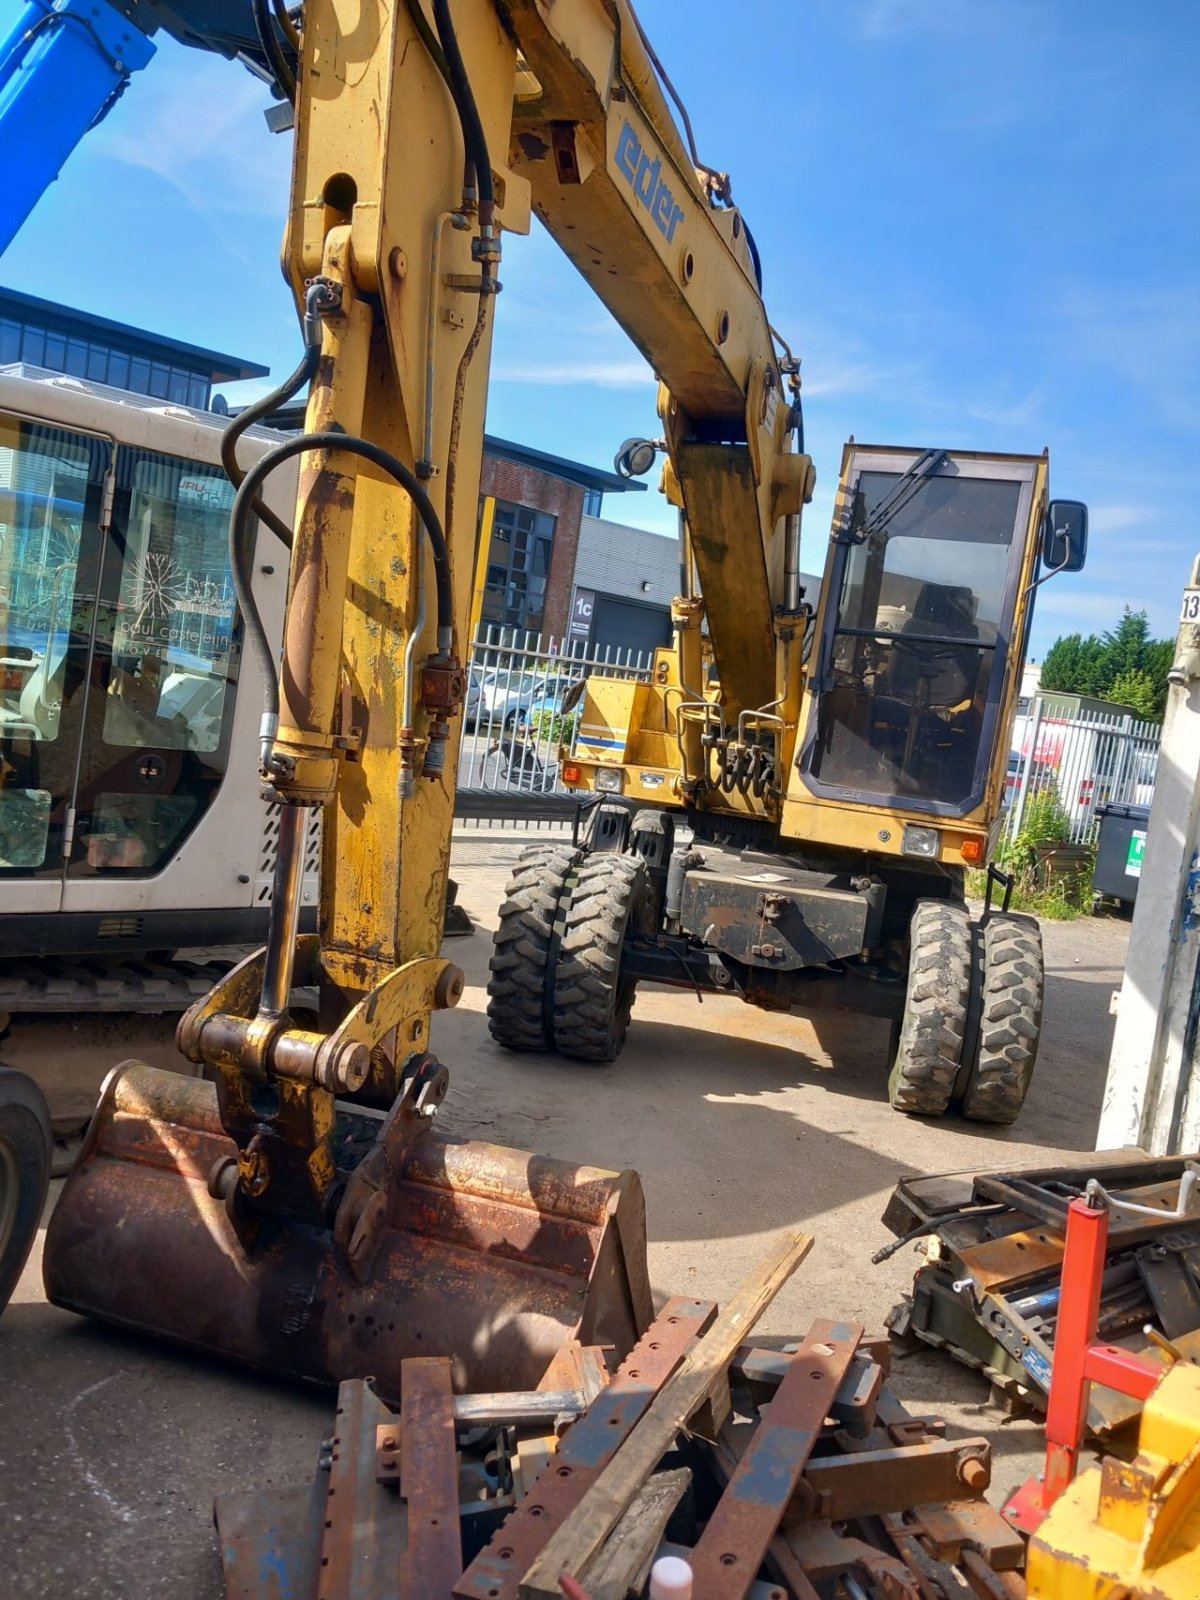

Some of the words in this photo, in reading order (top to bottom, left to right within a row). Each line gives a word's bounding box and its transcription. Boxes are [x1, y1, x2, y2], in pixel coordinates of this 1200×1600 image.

[614, 119, 686, 245] eder
[576, 598, 592, 616] 1c
[1183, 595, 1200, 618] 13
[120, 619, 154, 638] paul
